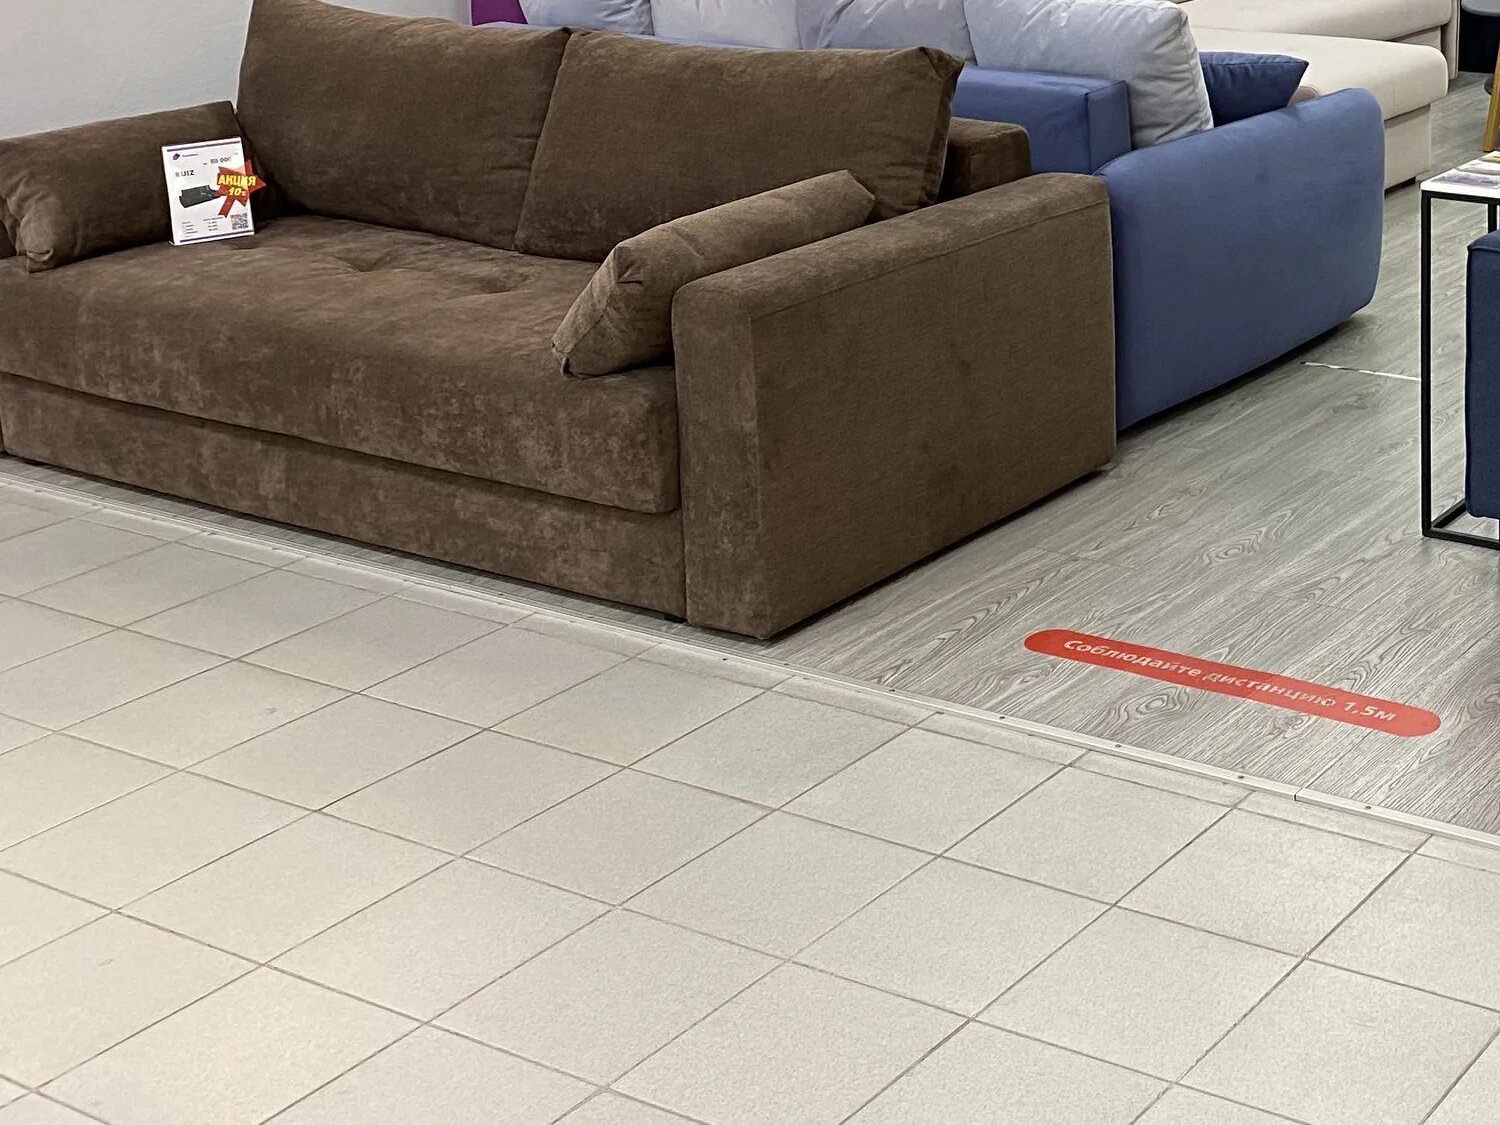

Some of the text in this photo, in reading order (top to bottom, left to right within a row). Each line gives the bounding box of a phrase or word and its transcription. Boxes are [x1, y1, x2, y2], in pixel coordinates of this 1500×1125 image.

[218, 174, 257, 187] АКЦИЯ
[1063, 640, 1397, 722] Соблюдайте дистанцию 1,5м
